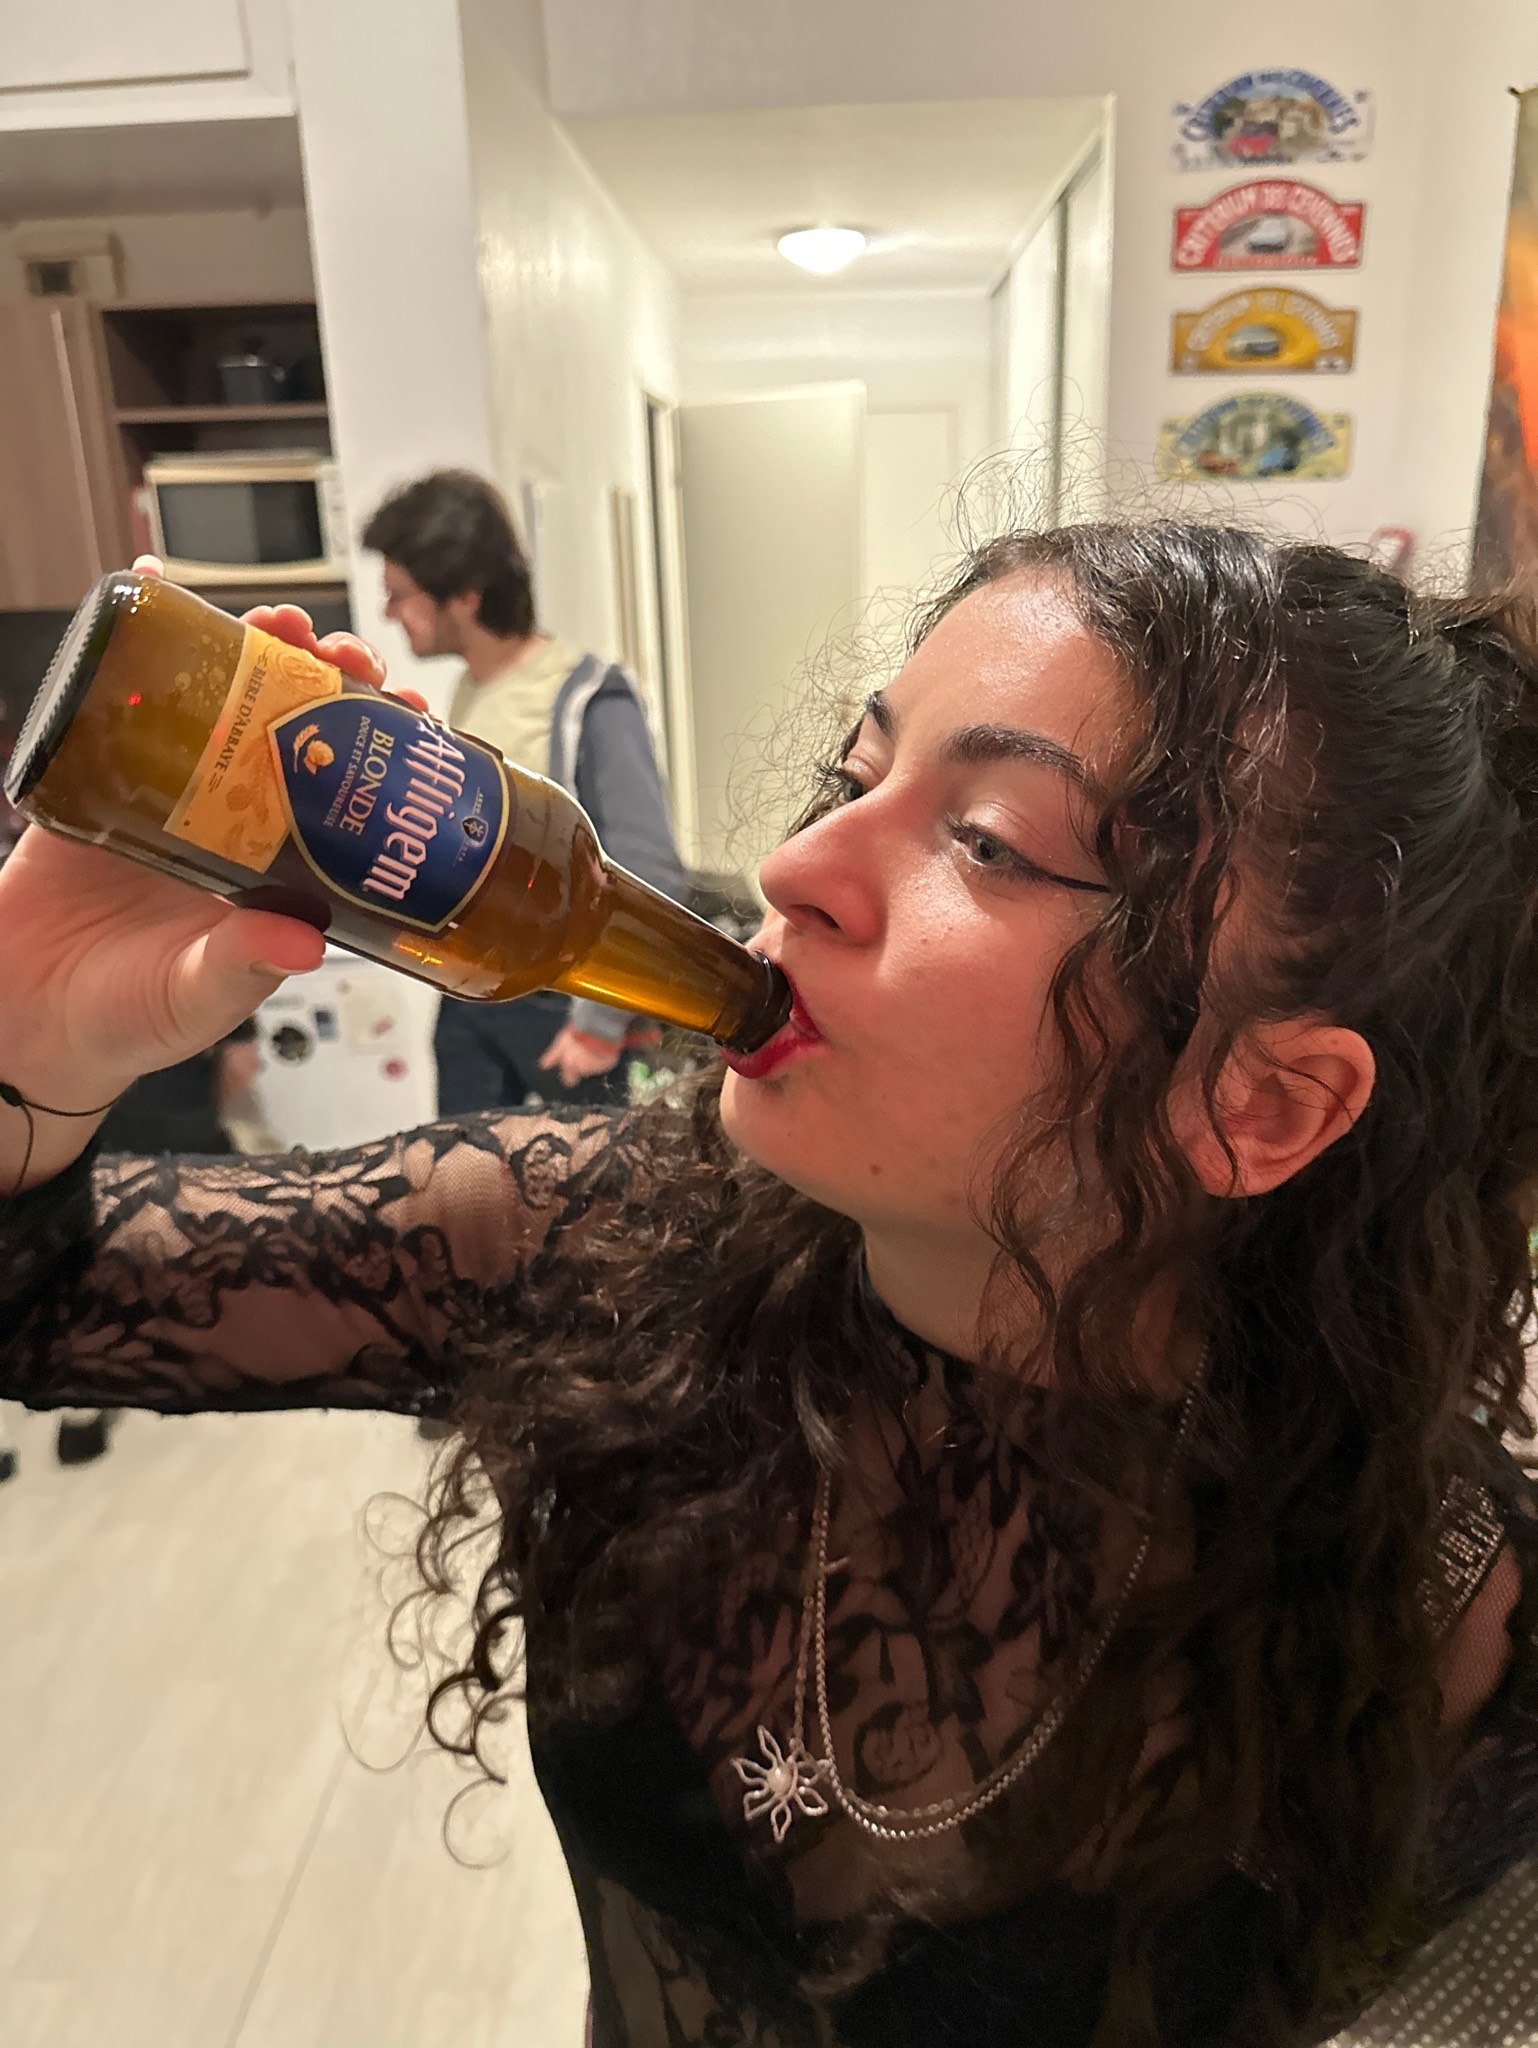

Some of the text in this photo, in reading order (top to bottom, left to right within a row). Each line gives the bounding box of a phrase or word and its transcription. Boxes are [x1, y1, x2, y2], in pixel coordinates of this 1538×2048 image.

[215, 665, 266, 773] BIÈRE D'ABBAYE
[323, 715, 371, 827] DOUCE ET SAVOUREUSE
[339, 728, 395, 837] BLONDE
[361, 712, 466, 901] Affligem
